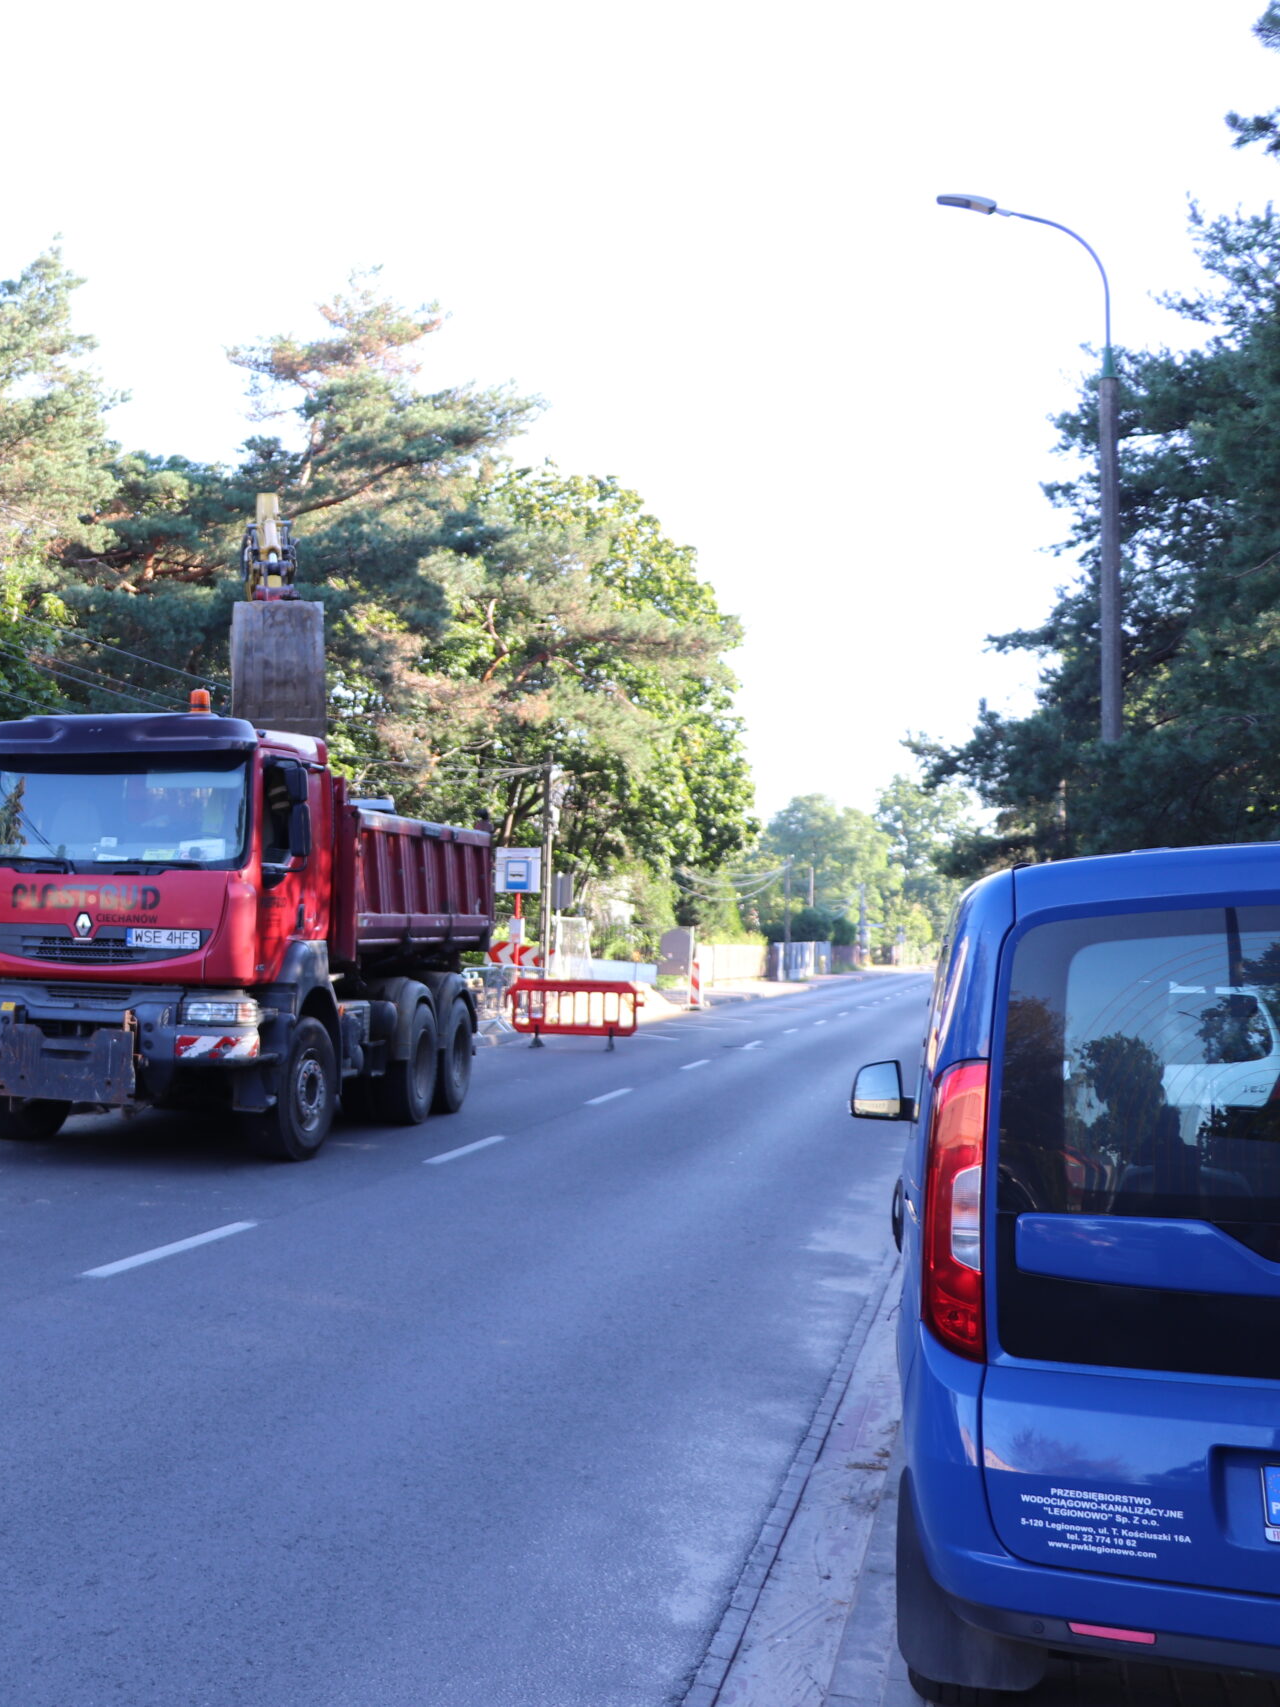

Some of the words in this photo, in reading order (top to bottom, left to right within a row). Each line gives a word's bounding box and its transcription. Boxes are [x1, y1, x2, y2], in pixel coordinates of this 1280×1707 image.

[96, 913, 158, 924] CIECHANÓW
[135, 930, 162, 944] WSE
[166, 931, 199, 946] 4HF5
[1050, 1488, 1151, 1505] PRZEDSIĘBIORSTWO
[1021, 1494, 1184, 1519] WODOCIĄGOWO-KANALIZACYJNE
[1115, 1514, 1130, 1524] Sp.
[1133, 1516, 1140, 1524] Z
[1045, 1521, 1096, 1534] Legionowo,
[1121, 1529, 1171, 1541] Kościuszki
[1173, 1535, 1192, 1543] 16A
[1066, 1533, 1080, 1541] tel.
[1095, 1535, 1111, 1544] 774
[1126, 1539, 1137, 1547] 62
[1047, 1541, 1157, 1558] www.pwklegionowo.com
